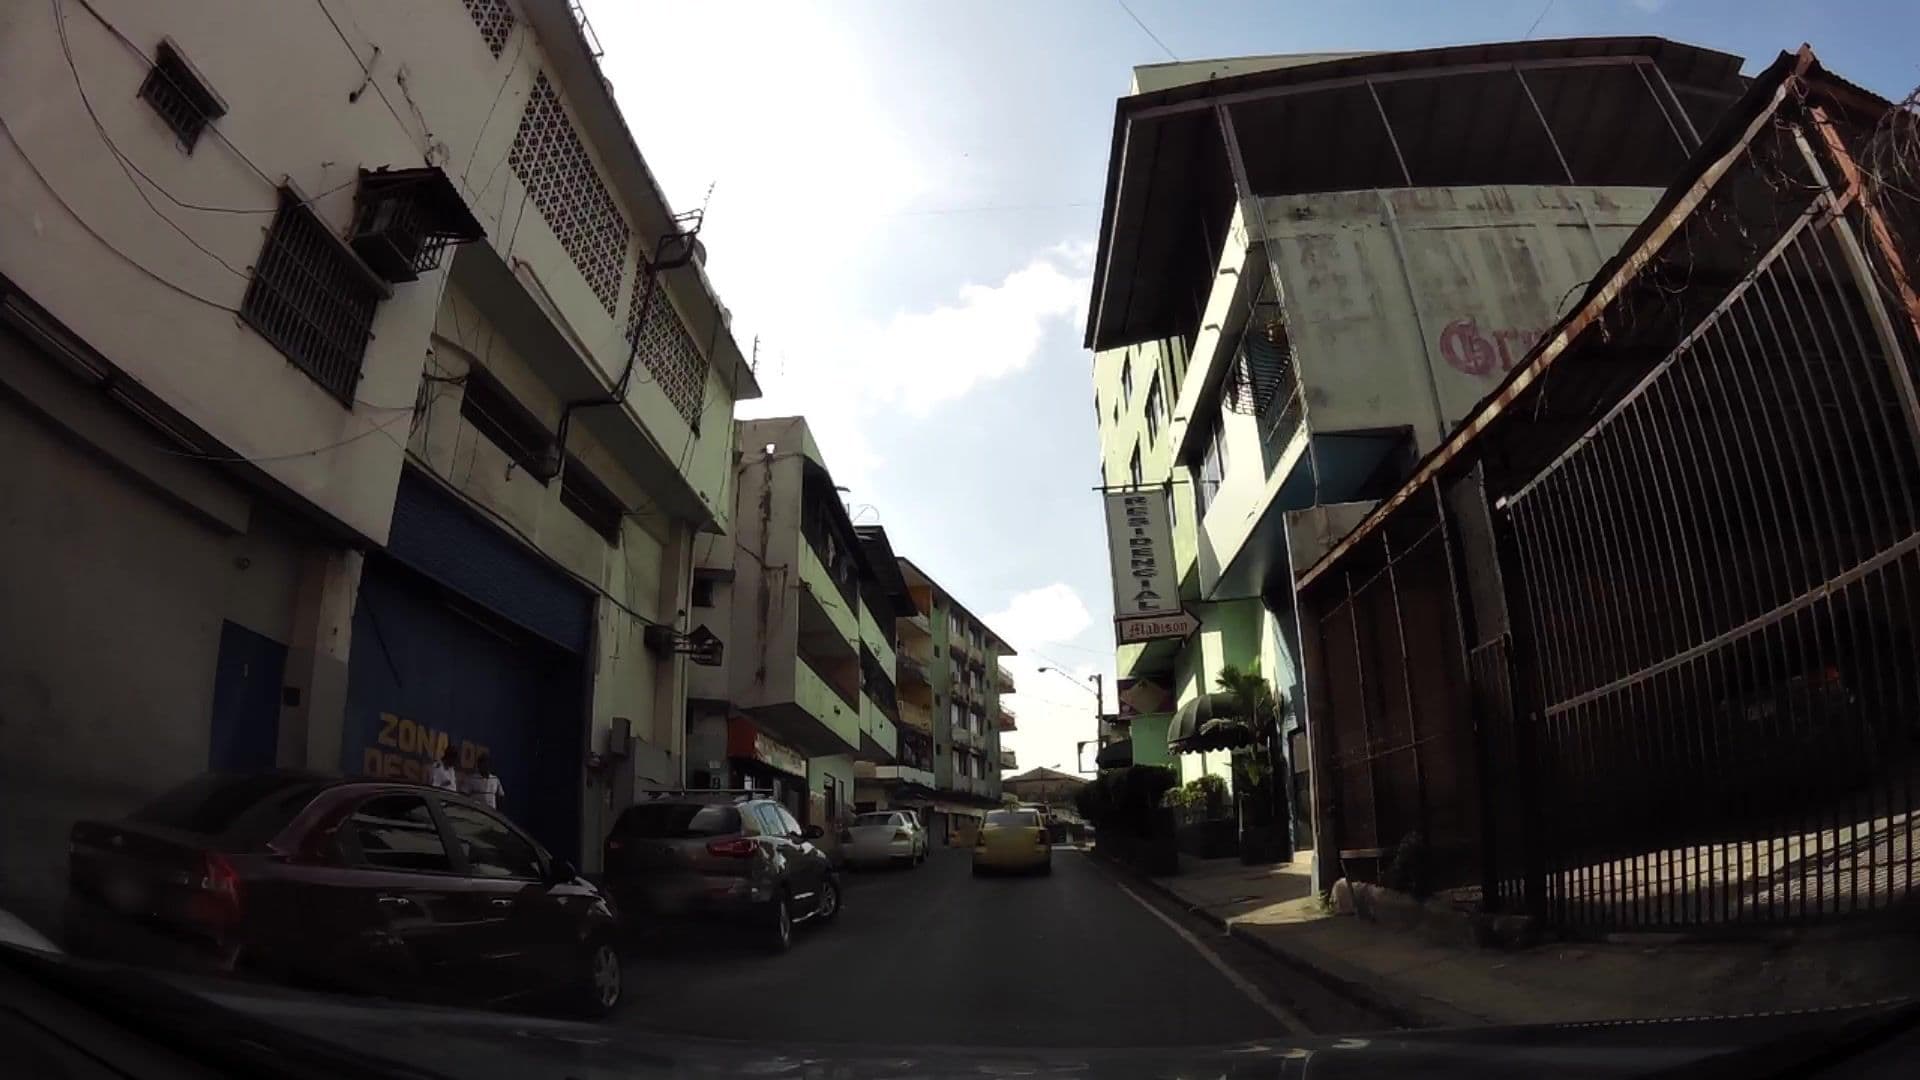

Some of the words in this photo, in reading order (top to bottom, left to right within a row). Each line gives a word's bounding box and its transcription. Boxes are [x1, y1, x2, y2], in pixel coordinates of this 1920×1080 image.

[1126, 496, 1160, 611] RESIDENCIAL
[1130, 622, 1188, 637] Madison
[378, 712, 449, 760] ZONA
